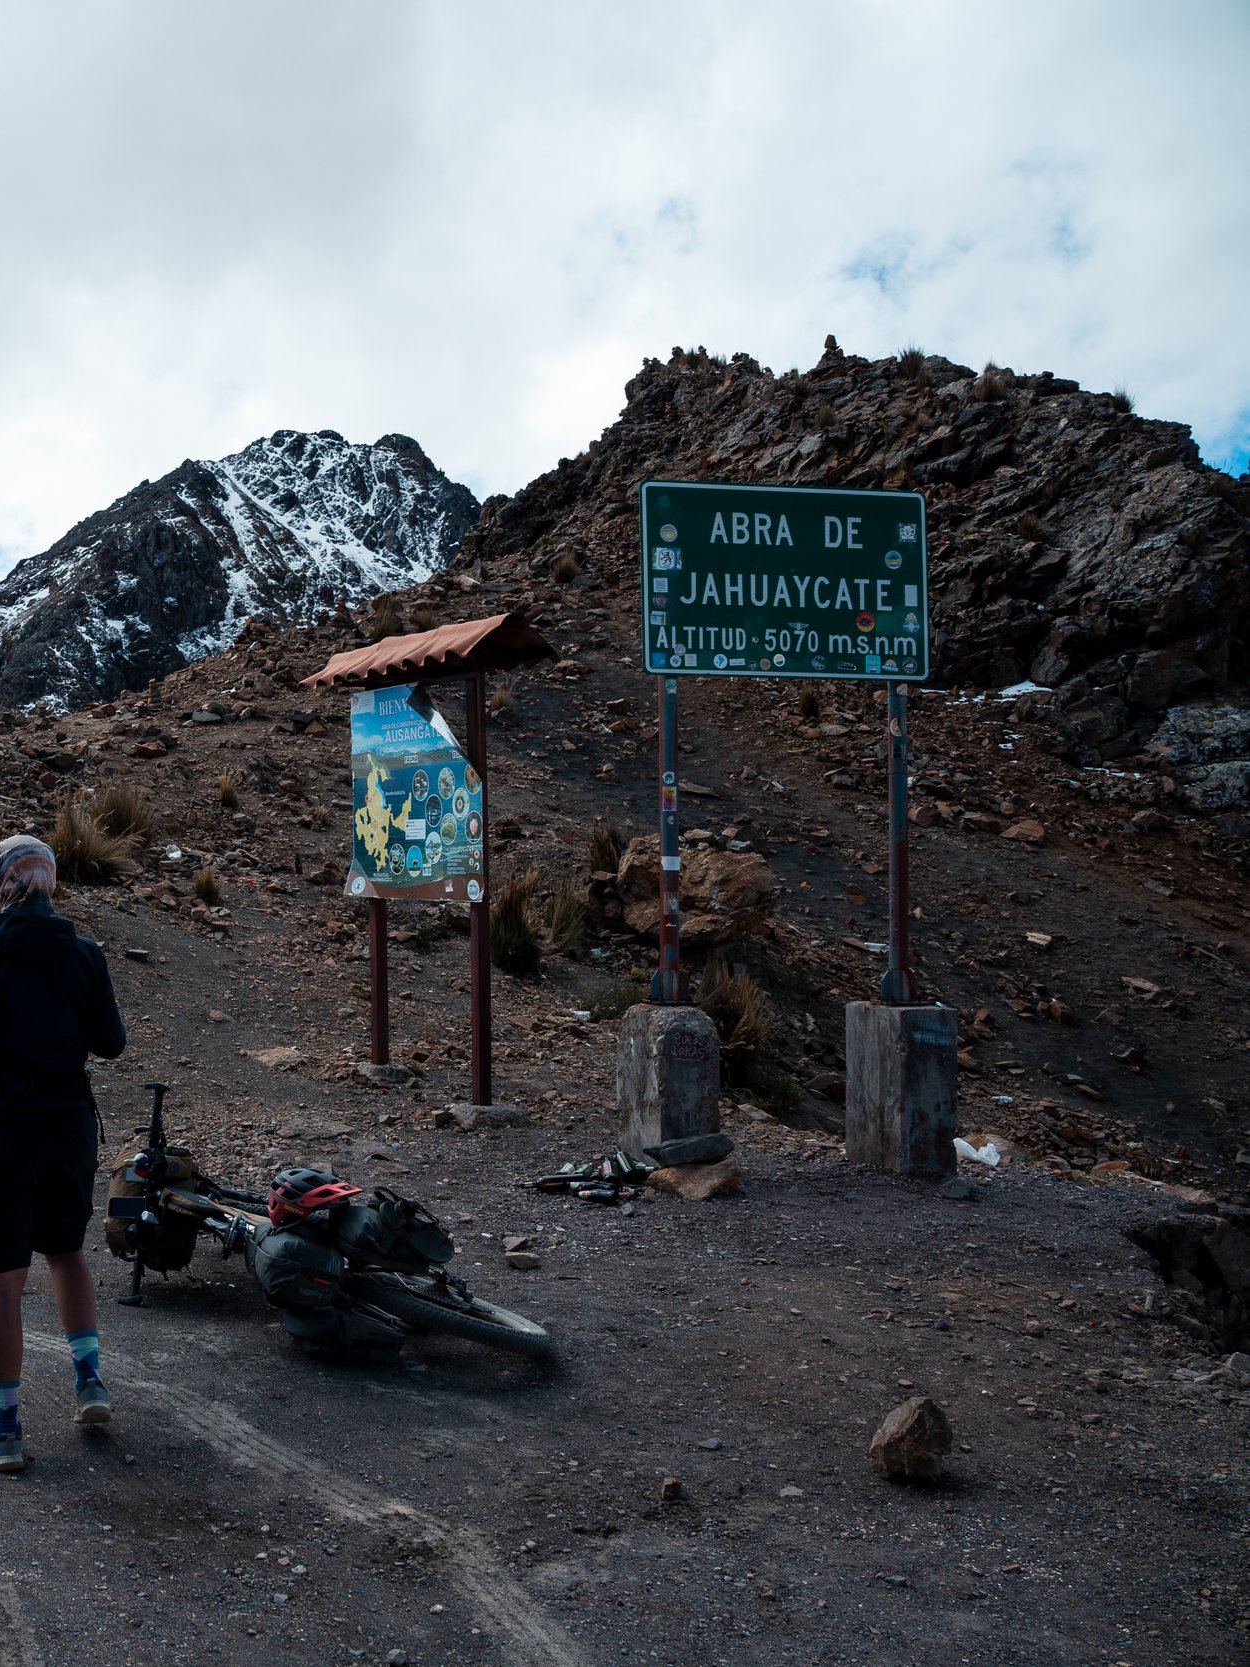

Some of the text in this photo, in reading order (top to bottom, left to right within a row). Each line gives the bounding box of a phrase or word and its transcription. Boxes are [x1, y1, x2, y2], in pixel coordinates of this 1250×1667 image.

[710, 512, 864, 550] ABRA DE
[679, 571, 893, 612] JAHUAYCATE
[656, 625, 917, 656] ALTITUD 5070 m.s.n.m
